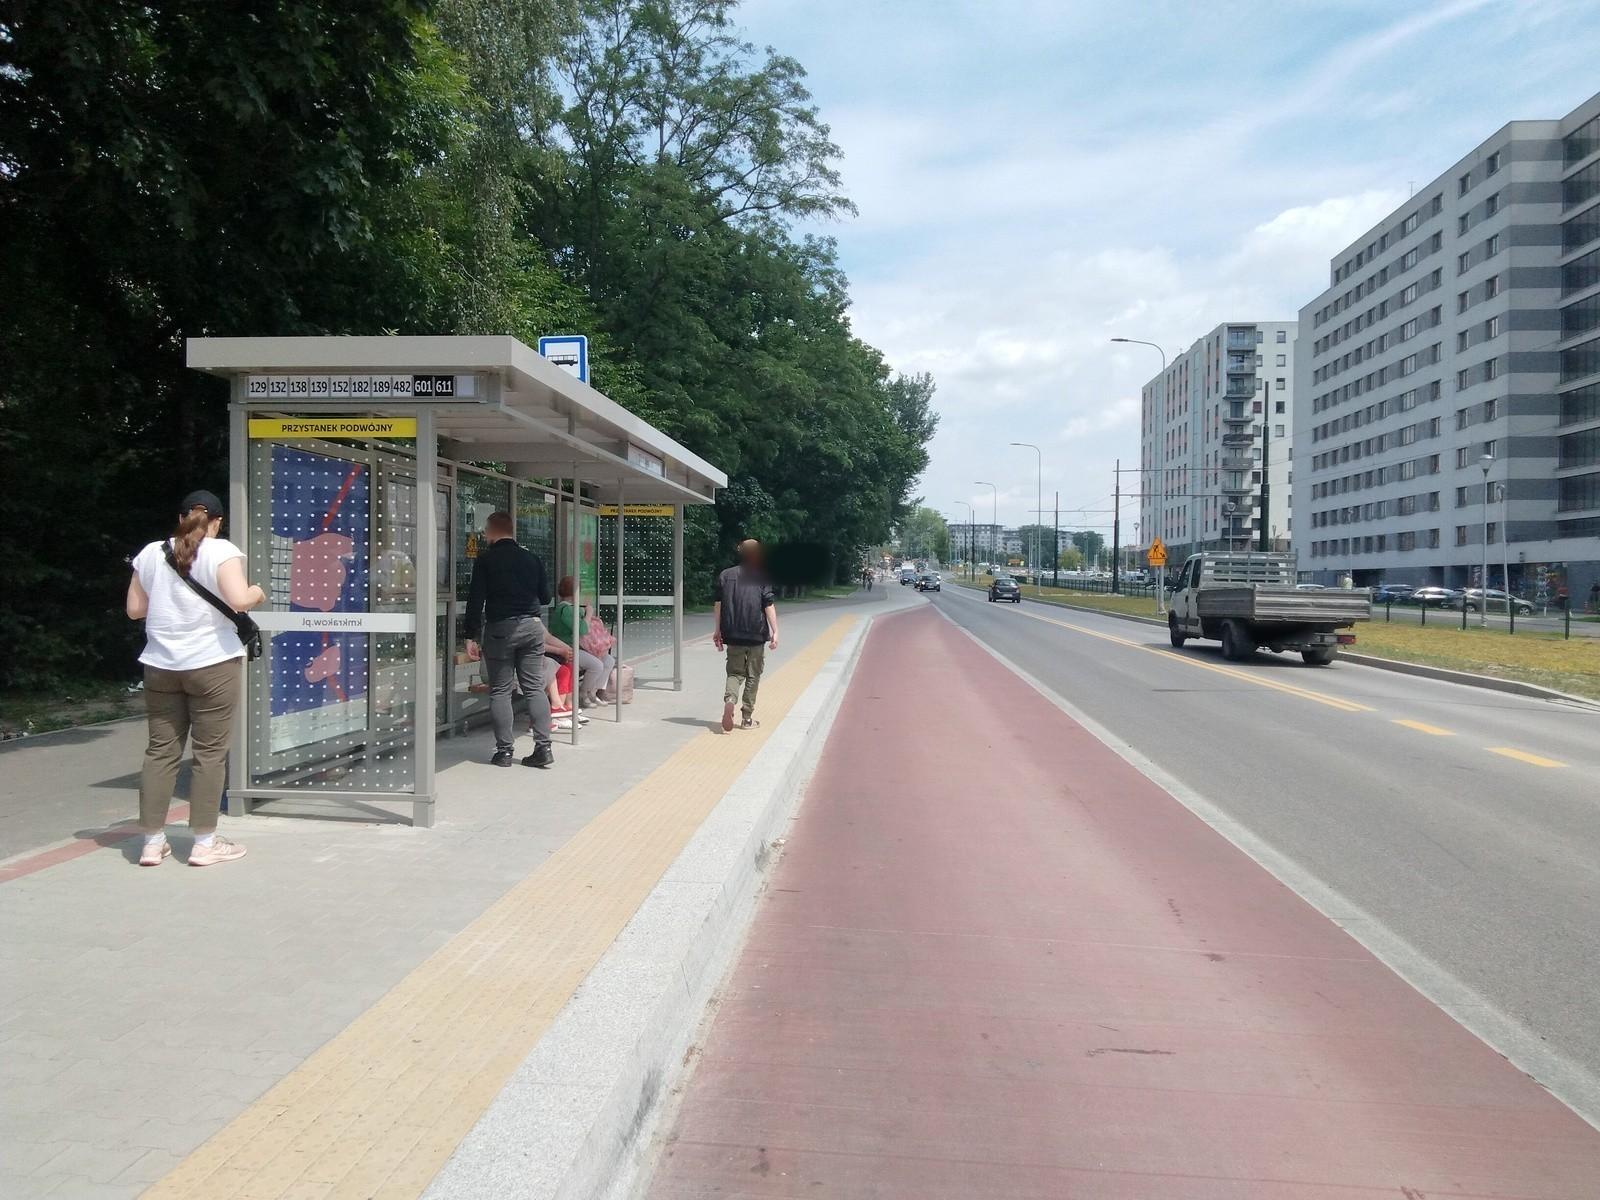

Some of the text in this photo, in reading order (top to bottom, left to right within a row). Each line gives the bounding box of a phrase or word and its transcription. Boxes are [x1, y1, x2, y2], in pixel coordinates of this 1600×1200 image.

[250, 380, 453, 393] 129 132 138 139 152 182 189 482 601 611
[281, 422, 393, 433] PRZYSTANEK PODWÓJNY
